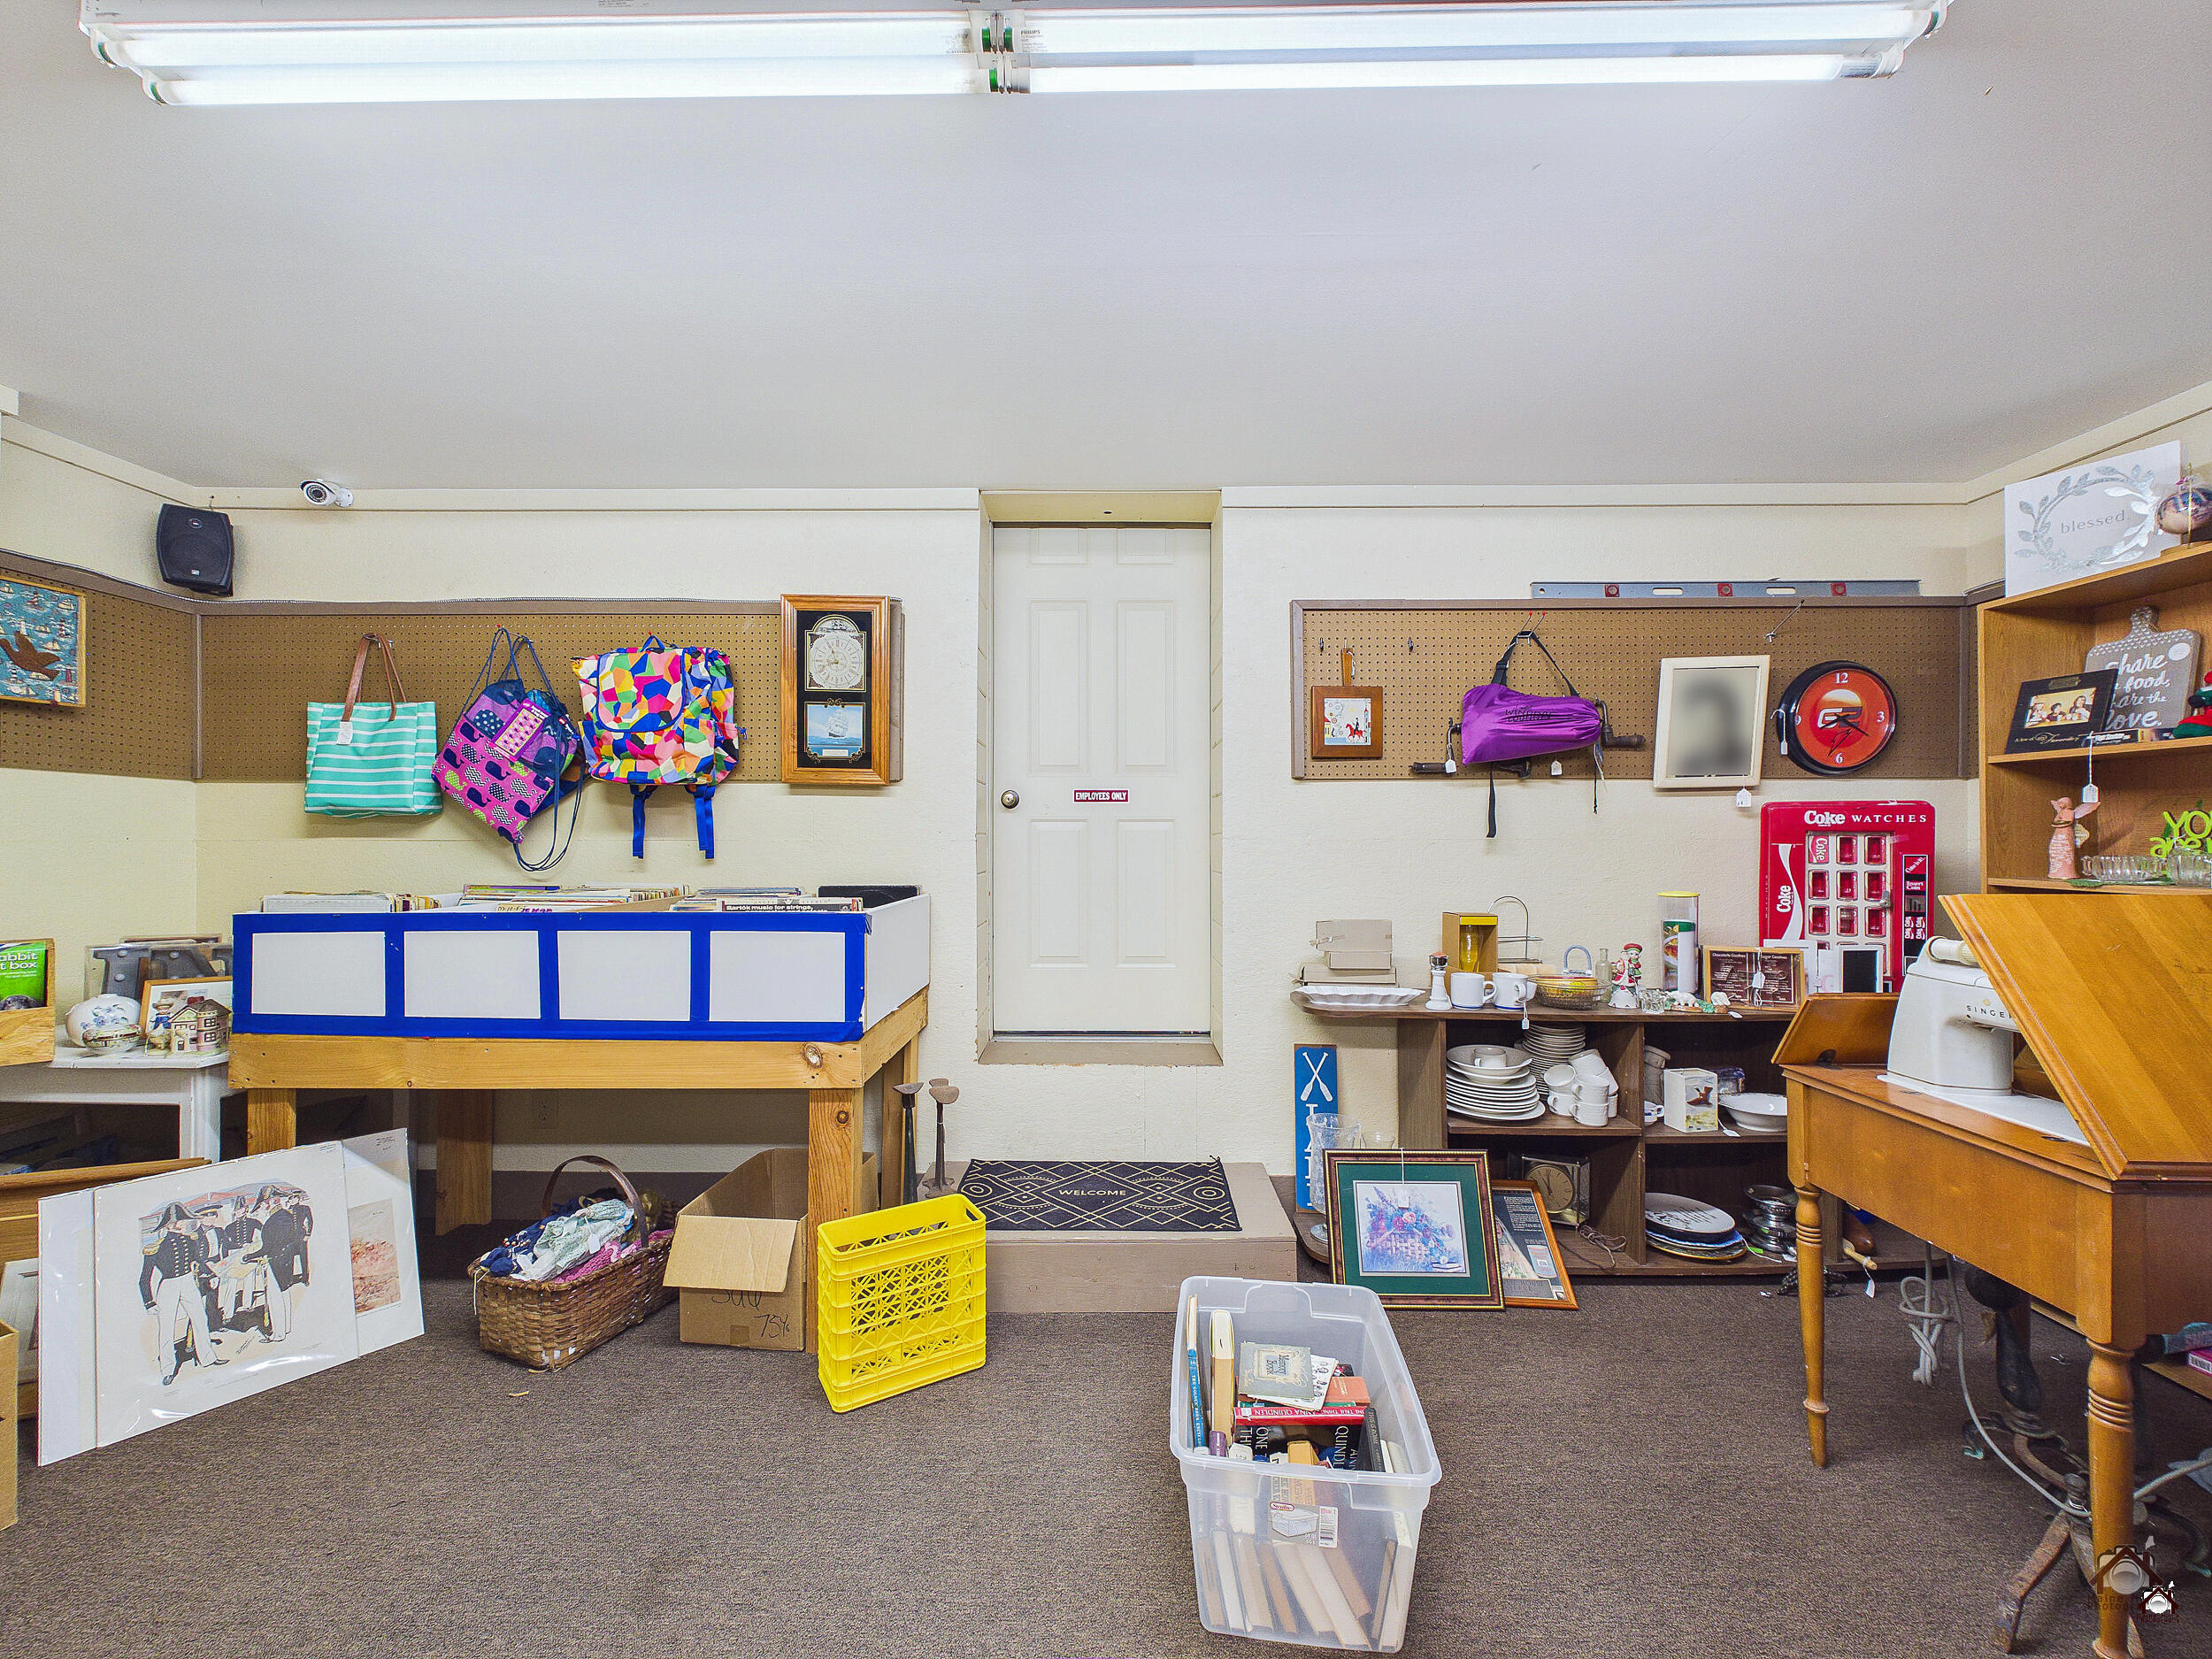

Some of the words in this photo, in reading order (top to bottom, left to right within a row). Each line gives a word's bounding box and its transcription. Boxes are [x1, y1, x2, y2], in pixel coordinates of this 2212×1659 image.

[2061, 510, 2131, 534] blessed.
[1834, 672, 1848, 684] 12
[1877, 710, 1886, 723] 3
[1835, 753, 1843, 764] 6
[1075, 791, 1110, 800] EMPLOYEES
[1111, 791, 1126, 800] ONLY
[1804, 810, 1846, 825] Coke
[1851, 814, 1927, 823] WATCHES
[2162, 810, 2212, 839] YO
[1816, 837, 1825, 861] Coke
[1776, 885, 1792, 913] Coke
[0, 952, 38, 961] abbit
[10, 961, 37, 970] box
[1255, 1426, 1269, 1449] ONE
[1333, 1425, 1349, 1470] QUINDL
